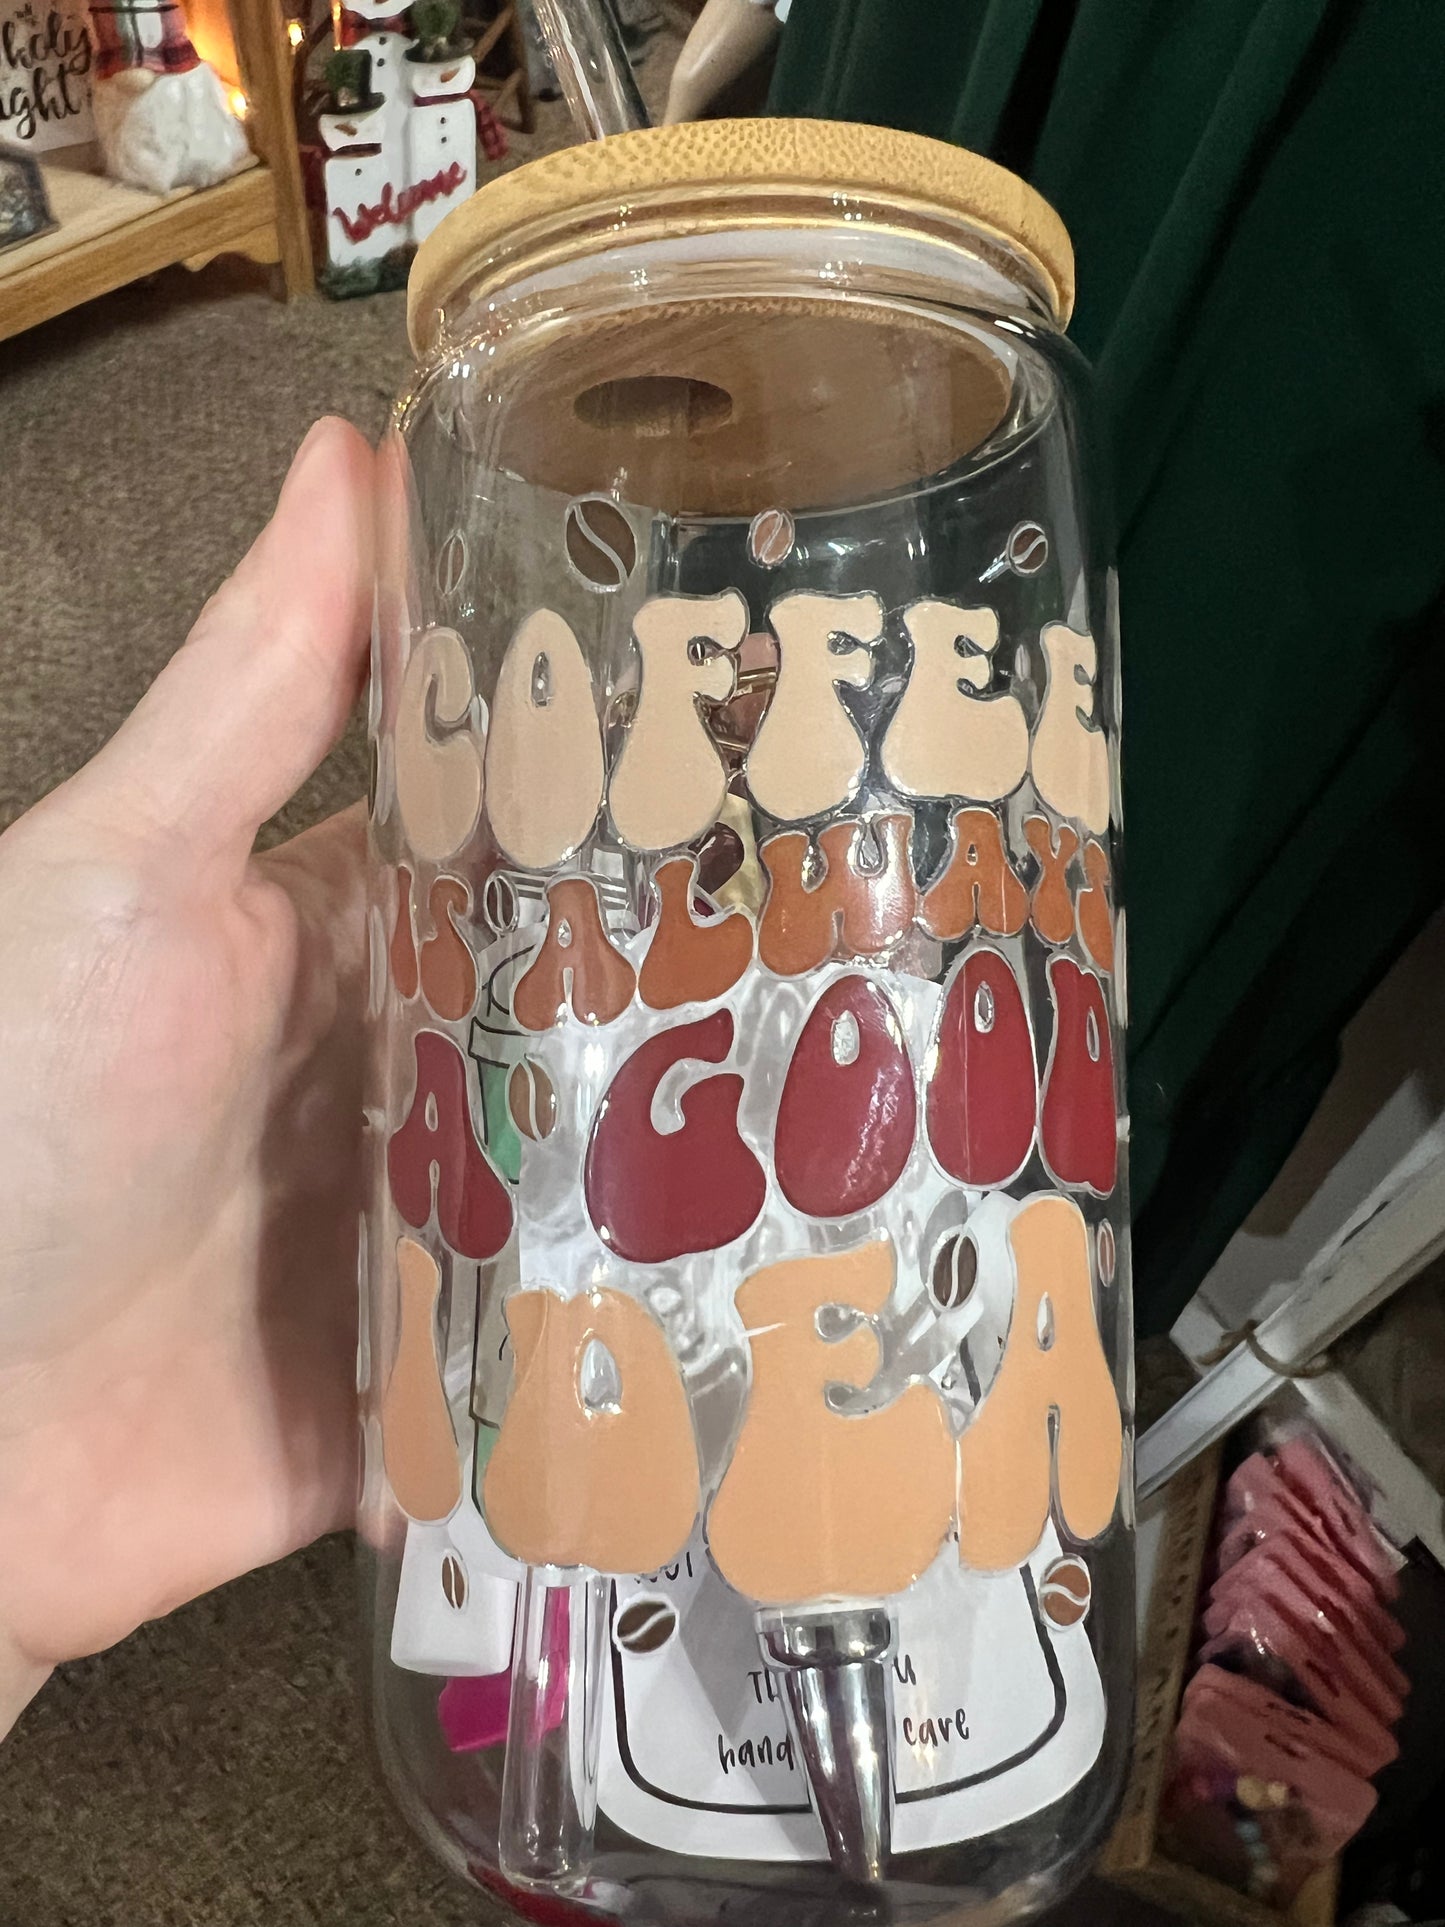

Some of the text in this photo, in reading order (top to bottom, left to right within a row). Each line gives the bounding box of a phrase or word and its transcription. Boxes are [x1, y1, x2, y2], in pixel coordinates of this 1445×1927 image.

[3, 9, 92, 76] holy
[395, 592, 1110, 869] COFFEE
[390, 807, 1114, 1031] IS ALWAYS
[387, 949, 1117, 1263] A GOOD
[383, 1197, 1122, 1600] IDEA
[902, 1708, 970, 1747] care
